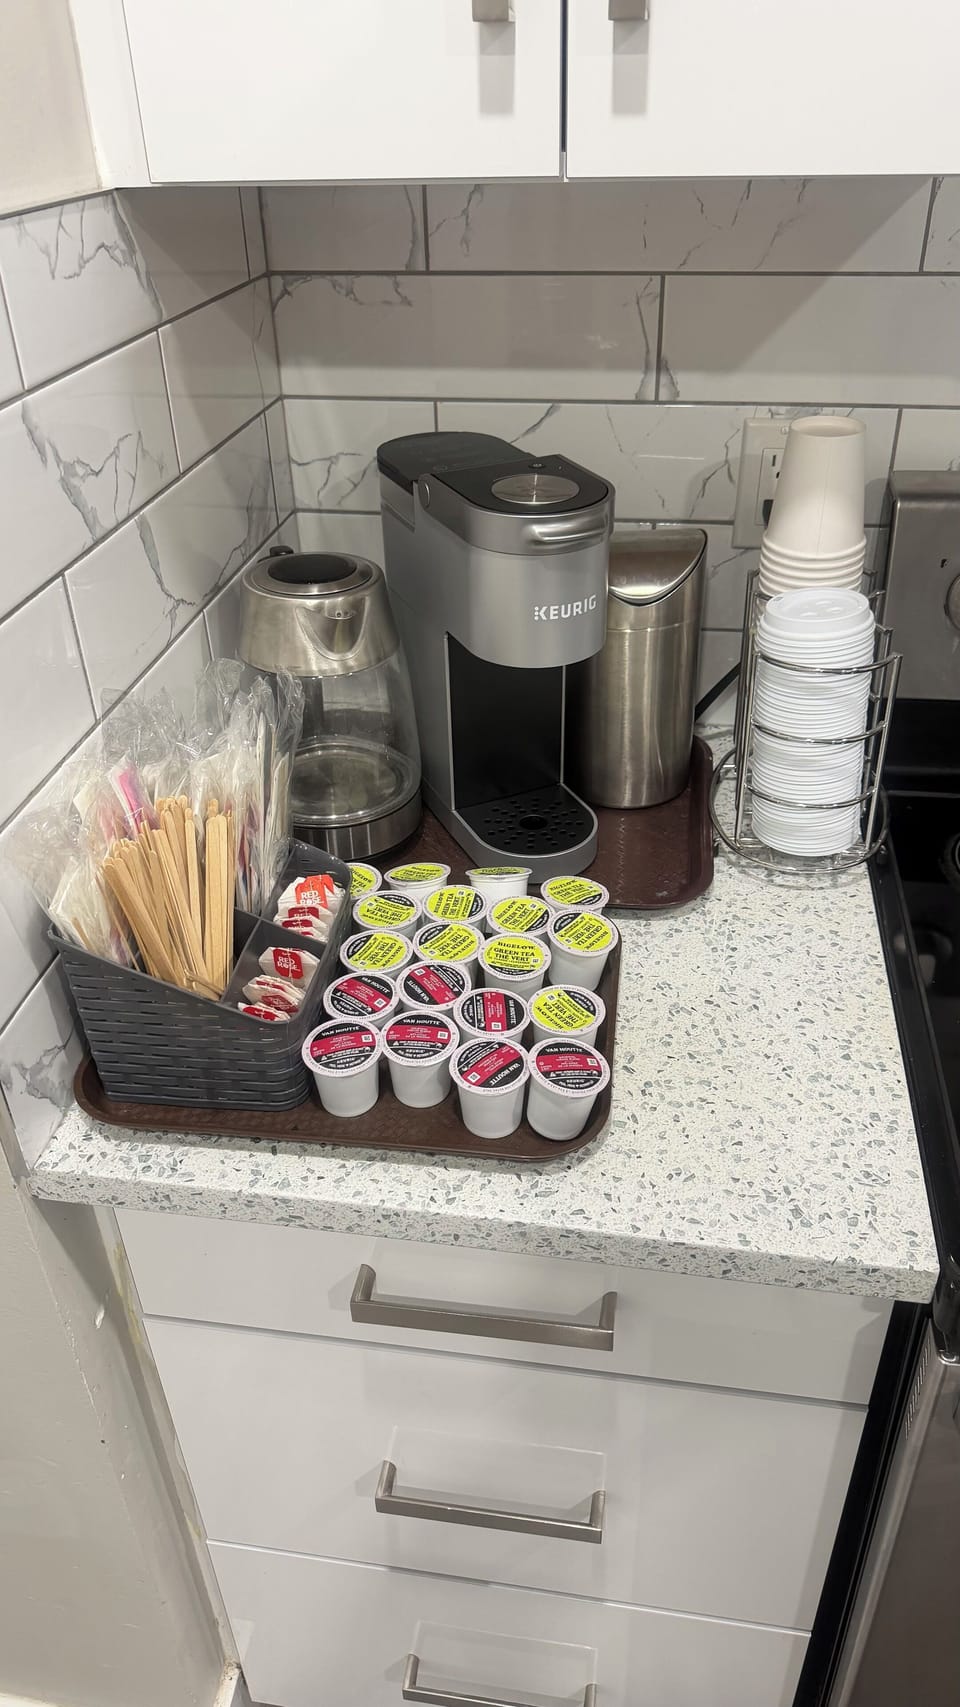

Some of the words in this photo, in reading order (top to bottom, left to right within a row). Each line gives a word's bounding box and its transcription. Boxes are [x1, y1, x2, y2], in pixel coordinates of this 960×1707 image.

[534, 594, 597, 621] KEURIG
[301, 890, 319, 900] RED
[498, 942, 535, 950] BIGELOW
[494, 948, 518, 956] GREEN
[278, 956, 296, 965] RED
[277, 961, 300, 971] ROSE
[543, 1002, 554, 1013] TEA
[508, 1062, 521, 1072] VAN
[490, 1069, 510, 1086] HOUTTE
